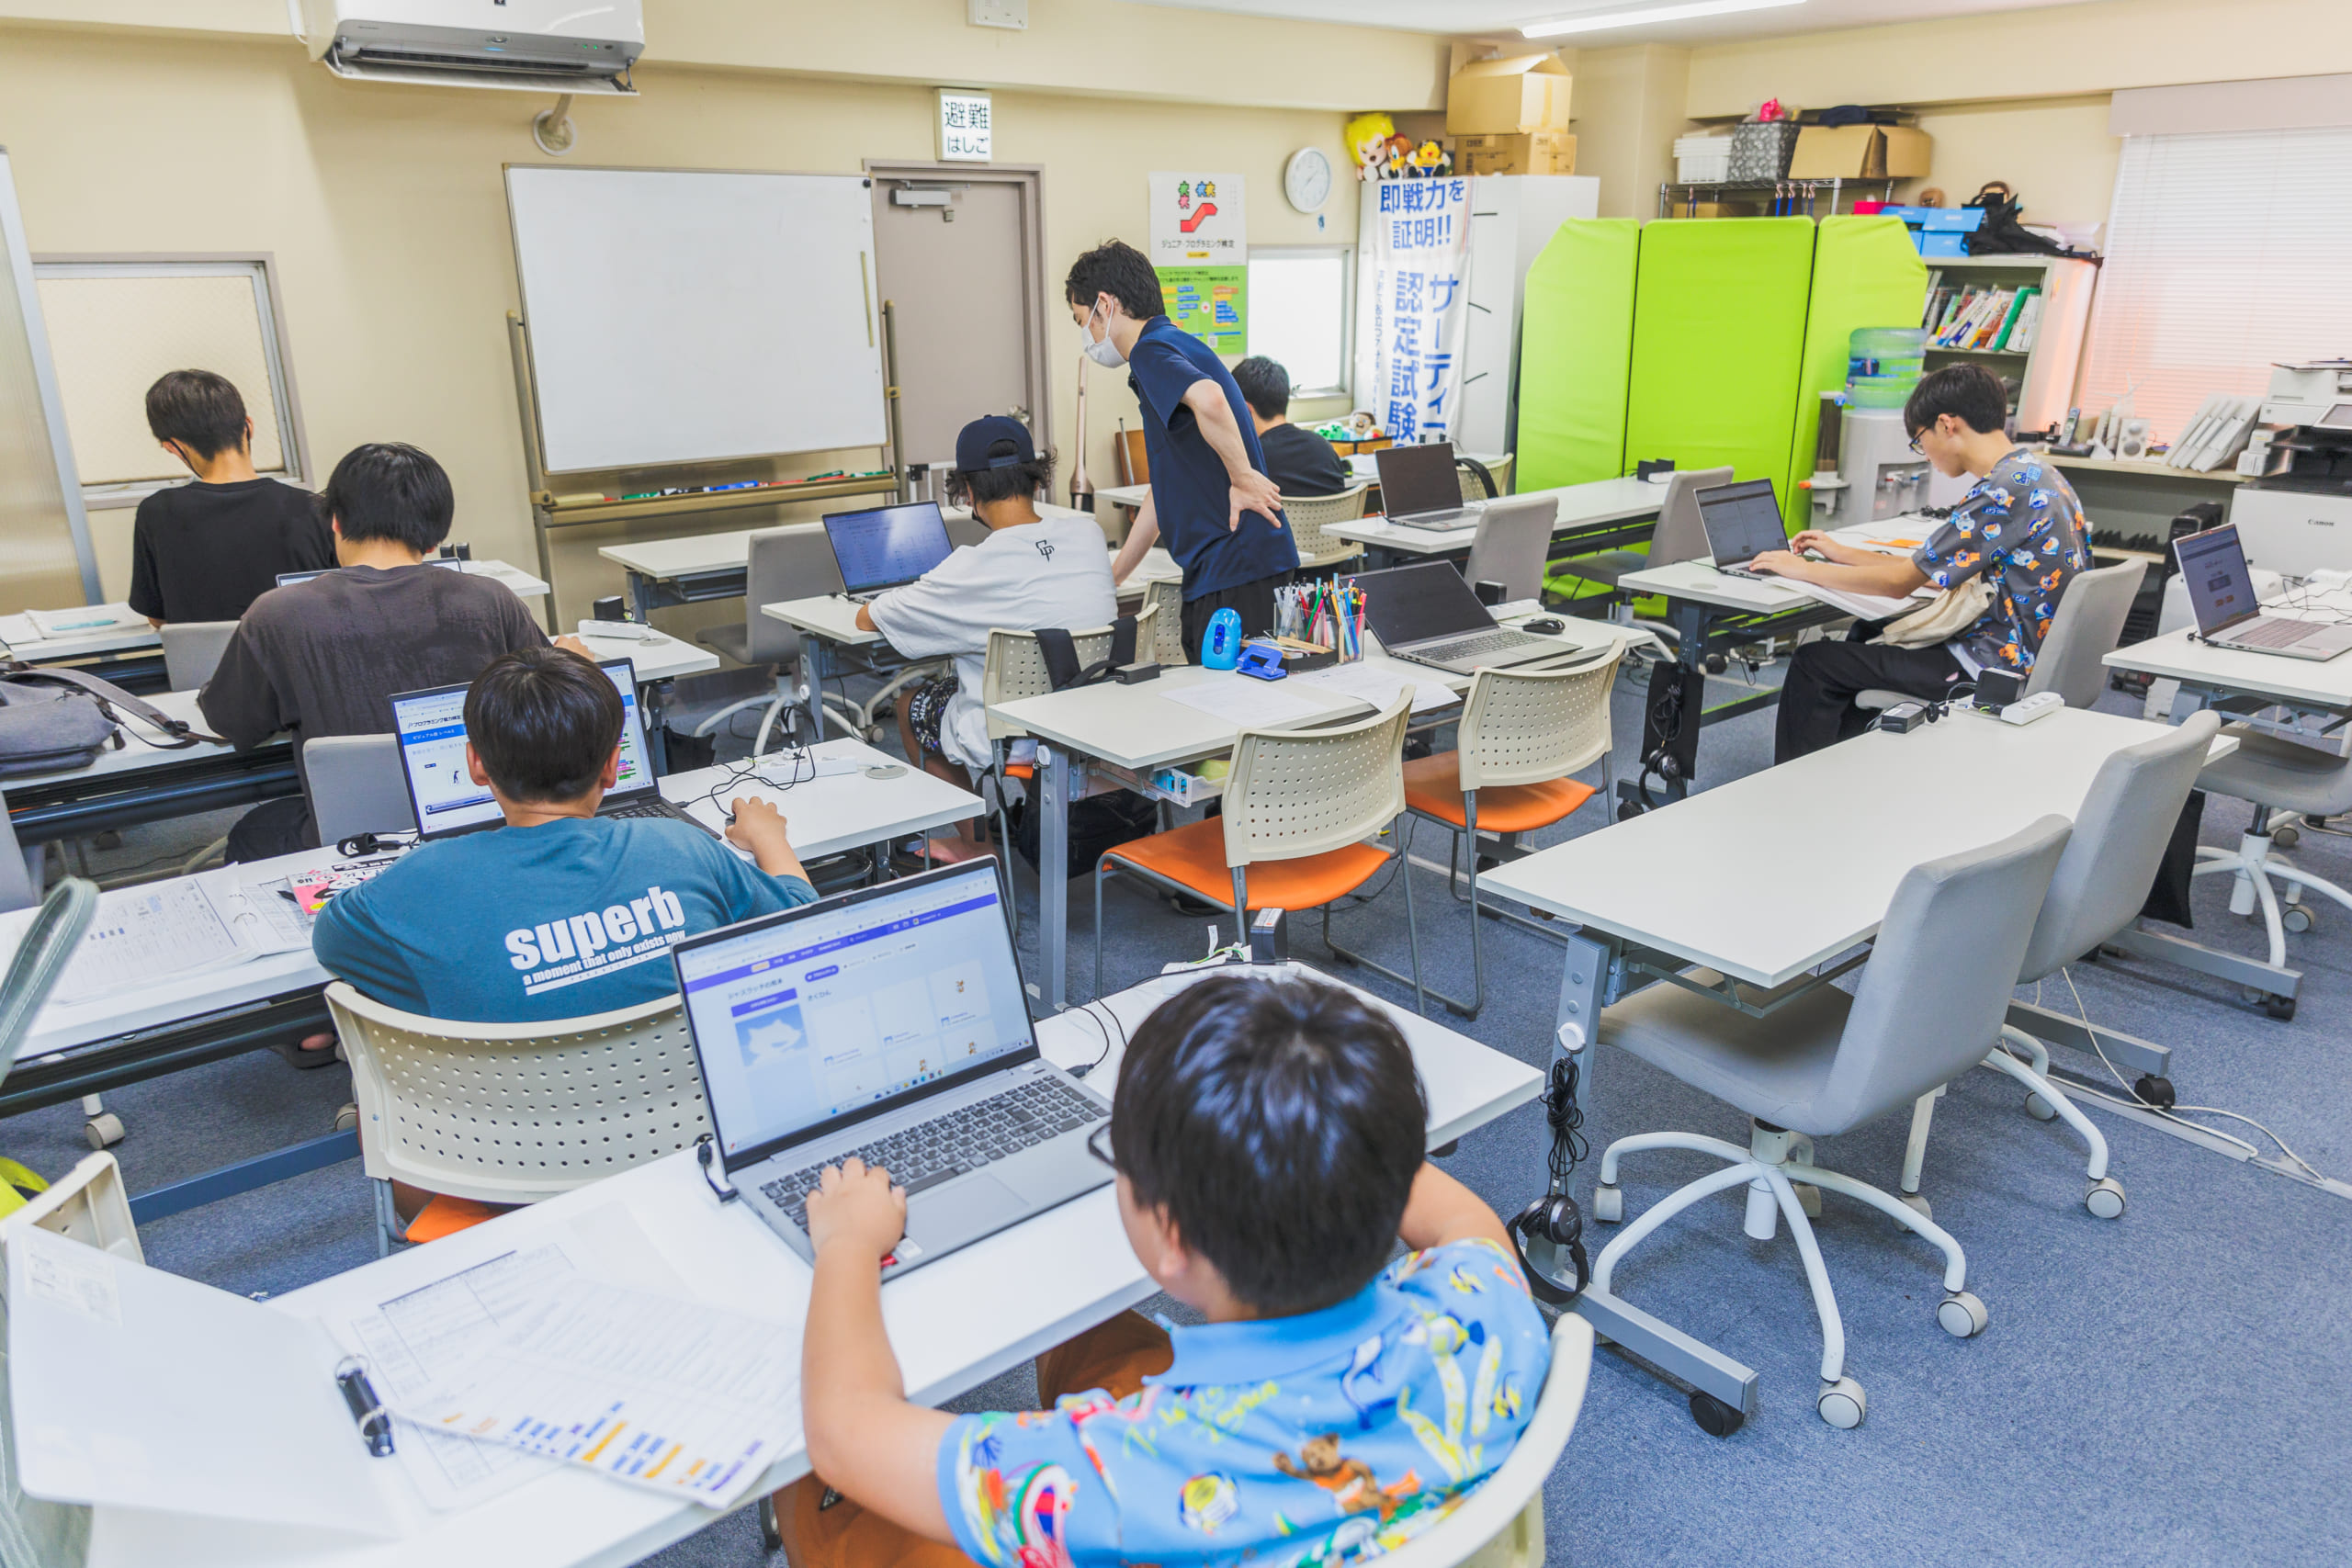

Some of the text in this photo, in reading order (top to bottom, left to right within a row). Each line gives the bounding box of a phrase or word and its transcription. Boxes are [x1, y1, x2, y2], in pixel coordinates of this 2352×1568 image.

[945, 102, 989, 129] 避難
[947, 135, 989, 153] はしご
[1380, 180, 1464, 214] 即戦力を
[505, 886, 685, 971] superb
[522, 930, 686, 986] a moment that only exists now
